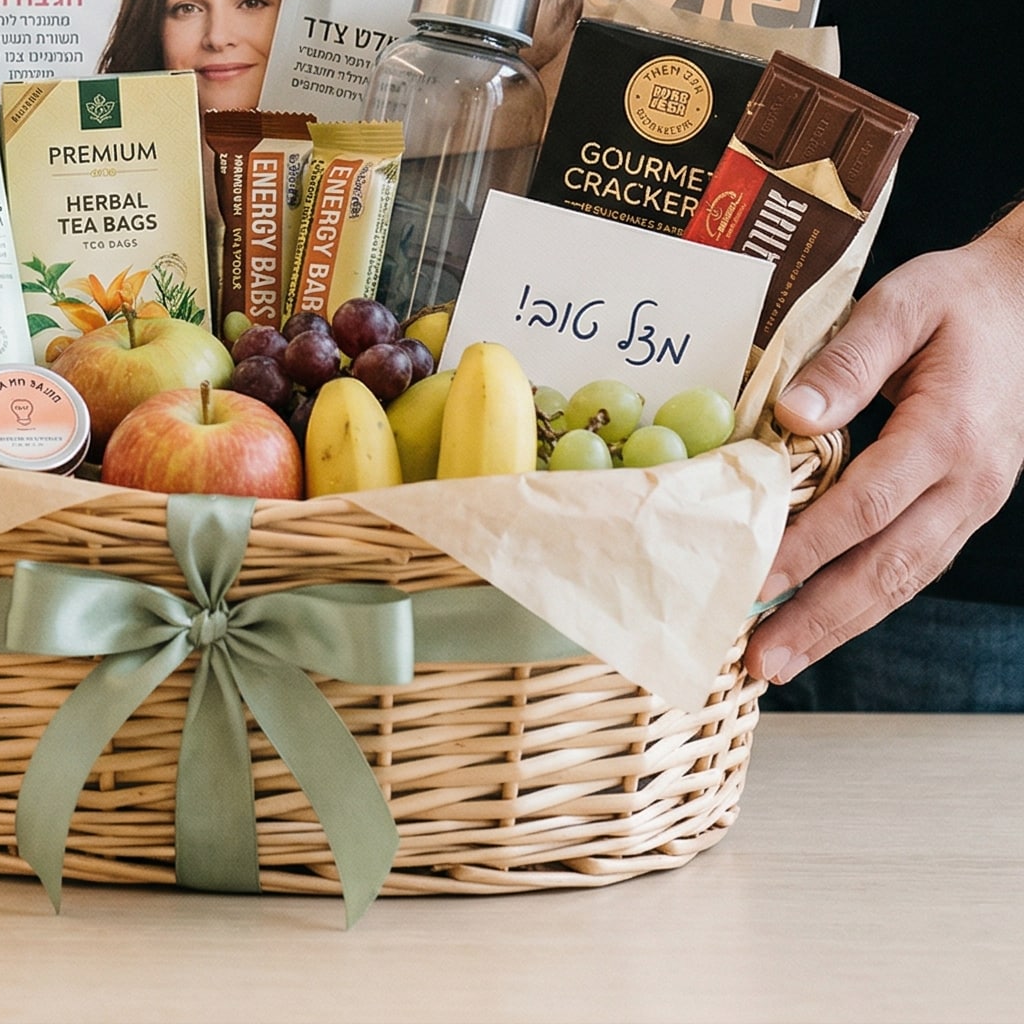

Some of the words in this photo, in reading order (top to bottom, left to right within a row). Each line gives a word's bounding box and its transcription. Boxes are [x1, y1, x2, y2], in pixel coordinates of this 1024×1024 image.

[49, 142, 157, 165] PREMIUM
[580, 141, 715, 193] GOURME
[67, 192, 148, 213] HERBAL
[251, 159, 278, 251] ENERGY
[312, 165, 354, 257] ENERGY
[563, 167, 700, 218] CRACKER
[57, 217, 98, 235] TEA
[103, 214, 158, 233] BAGS
